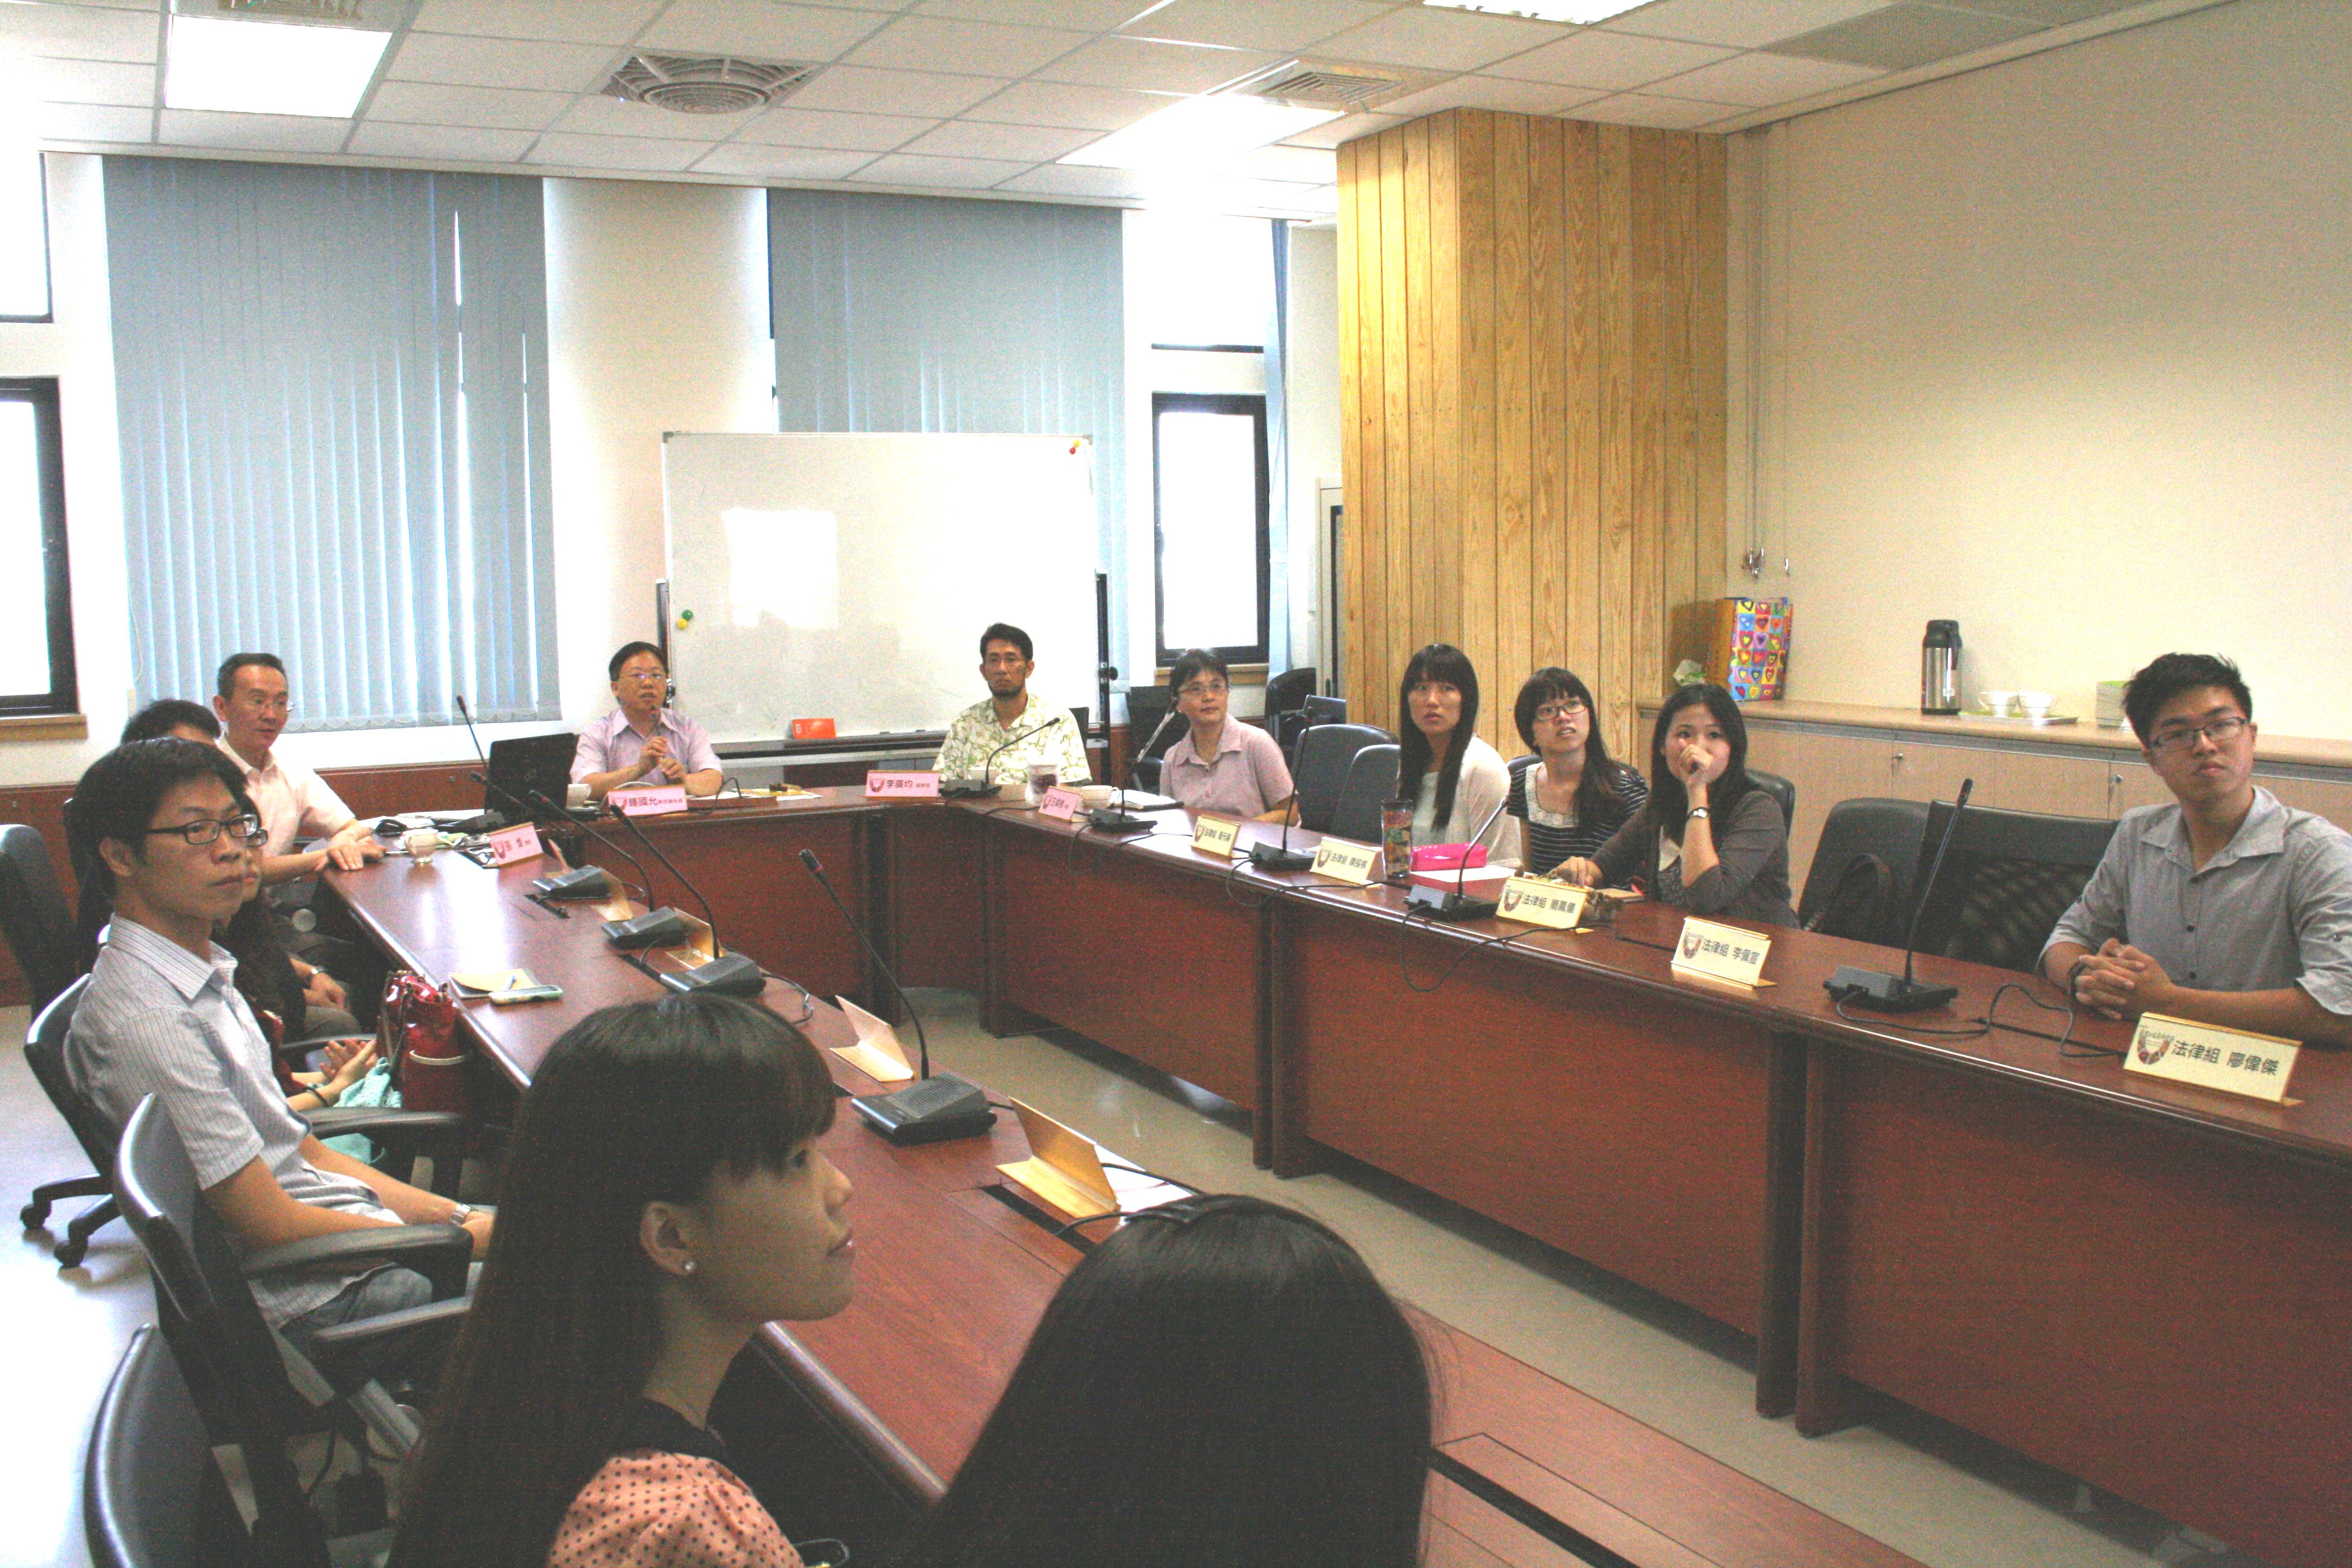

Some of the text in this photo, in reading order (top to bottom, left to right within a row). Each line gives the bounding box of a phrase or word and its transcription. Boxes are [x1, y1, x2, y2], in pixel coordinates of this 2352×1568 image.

[886, 779, 913, 789] 李廣均
[1521, 893, 1548, 909] 法律組
[1701, 938, 1730, 957] 法律組
[2171, 1039, 2279, 1076] 法律組 廖偉傑
